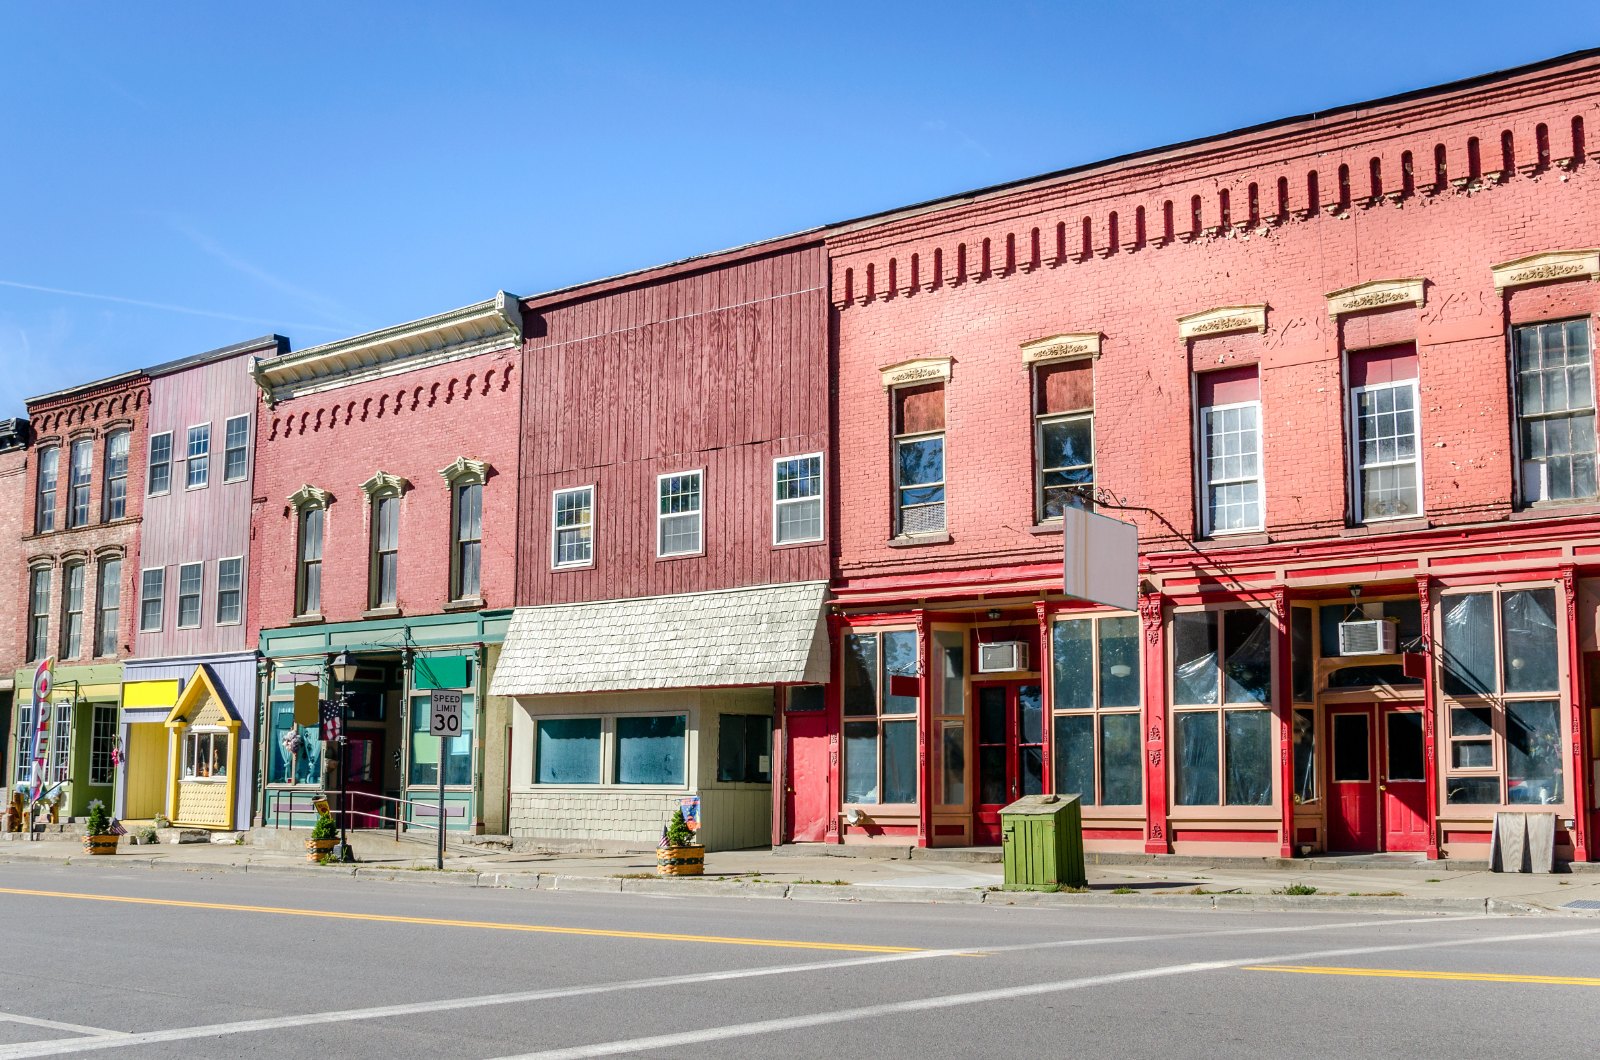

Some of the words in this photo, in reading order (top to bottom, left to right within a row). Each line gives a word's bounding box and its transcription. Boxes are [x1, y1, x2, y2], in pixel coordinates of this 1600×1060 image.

[433, 694, 460, 703] SPEED
[436, 704, 457, 713] LIMIT
[31, 669, 52, 790] OPEN
[433, 713, 459, 732] 30
